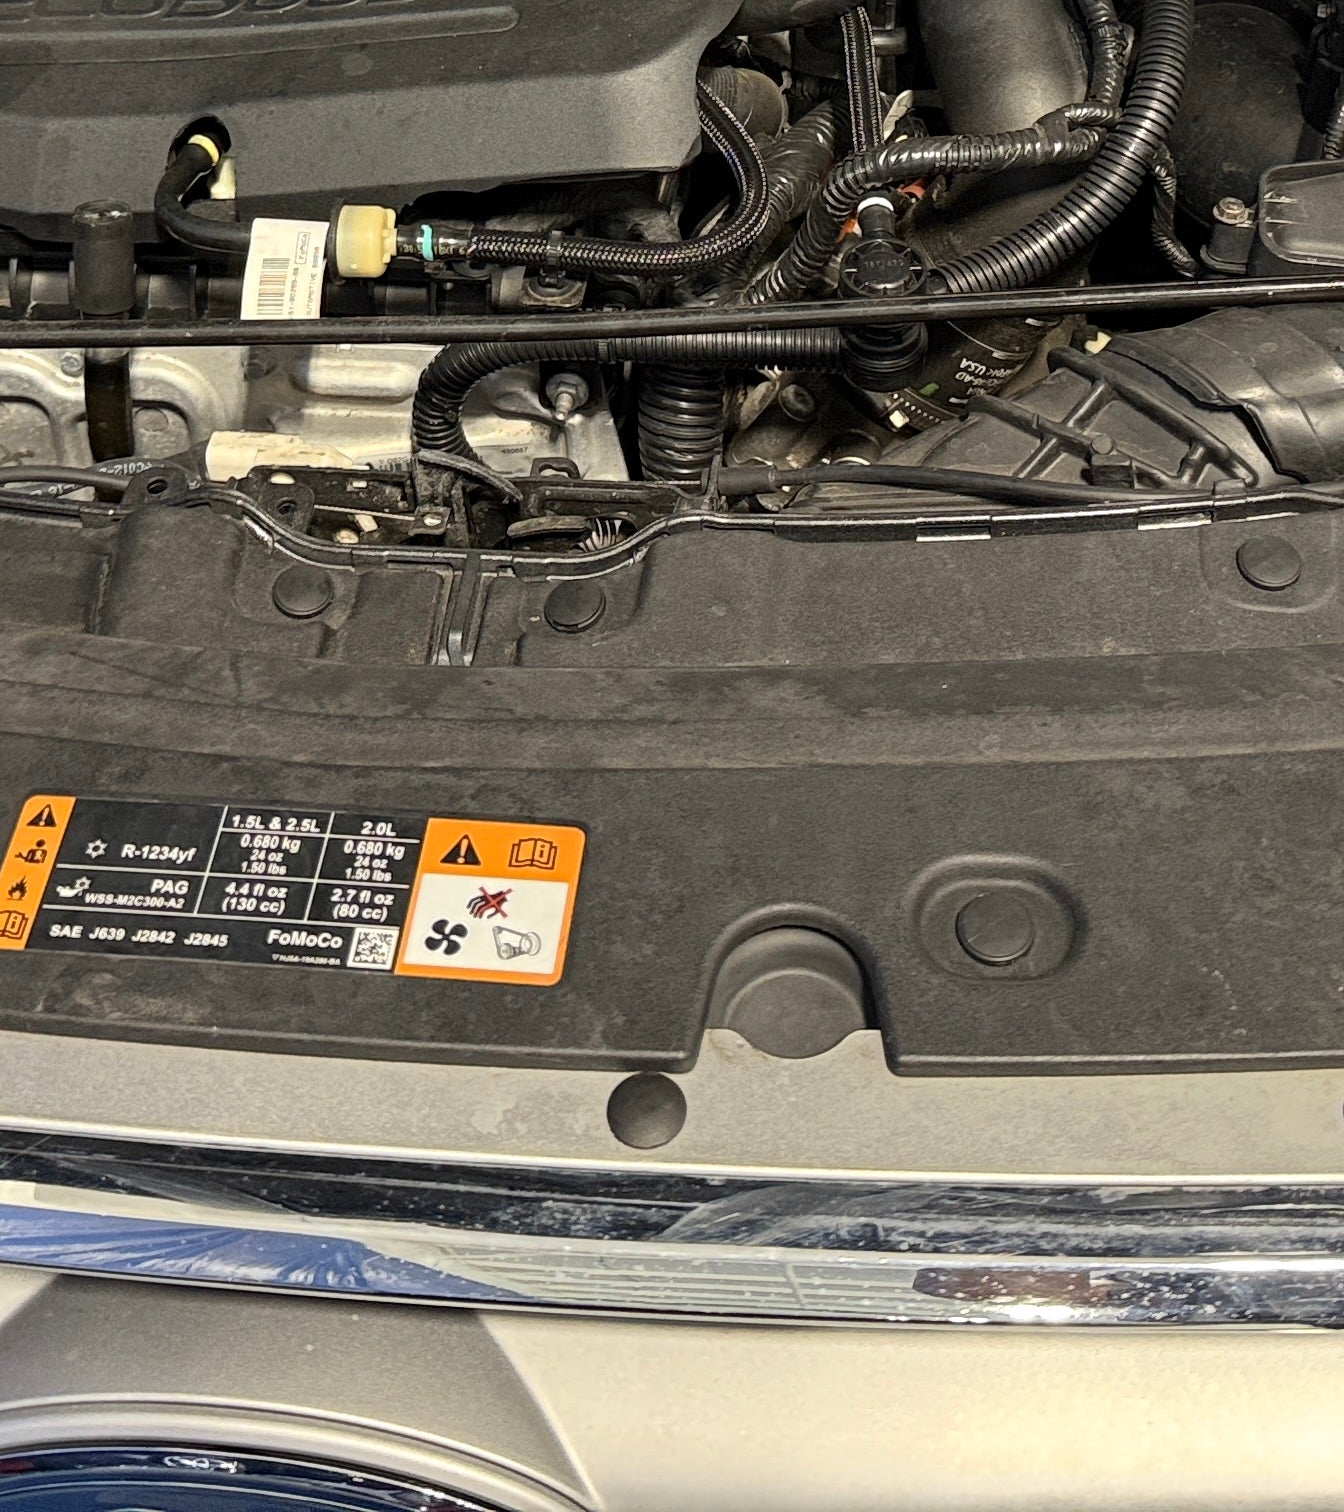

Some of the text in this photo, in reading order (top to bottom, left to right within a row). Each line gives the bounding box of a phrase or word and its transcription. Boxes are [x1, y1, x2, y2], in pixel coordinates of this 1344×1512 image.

[232, 814, 321, 833] 1.5L & 2.5L
[361, 821, 397, 837] 2.0L
[240, 834, 301, 854] 0.680 kg
[343, 840, 406, 861] 0.680 kg
[120, 843, 197, 864] R-1234yf
[249, 849, 284, 862] 24 oz
[353, 855, 388, 869] 24 oz
[241, 861, 287, 876] 1.50 lbs
[345, 867, 392, 883] 1.50 lbs
[150, 878, 190, 895] PAG
[224, 881, 288, 898] 4.4 fl oz
[84, 892, 185, 910] WSS-M2C300-A2
[330, 888, 395, 906] 2.7 fl oz
[221, 897, 286, 916] (130 cc)
[332, 904, 388, 923] (80 cc)
[49, 924, 84, 939] SAE
[88, 926, 126, 941] J639
[131, 929, 176, 944] J2842
[267, 929, 343, 949] FoMoCo
